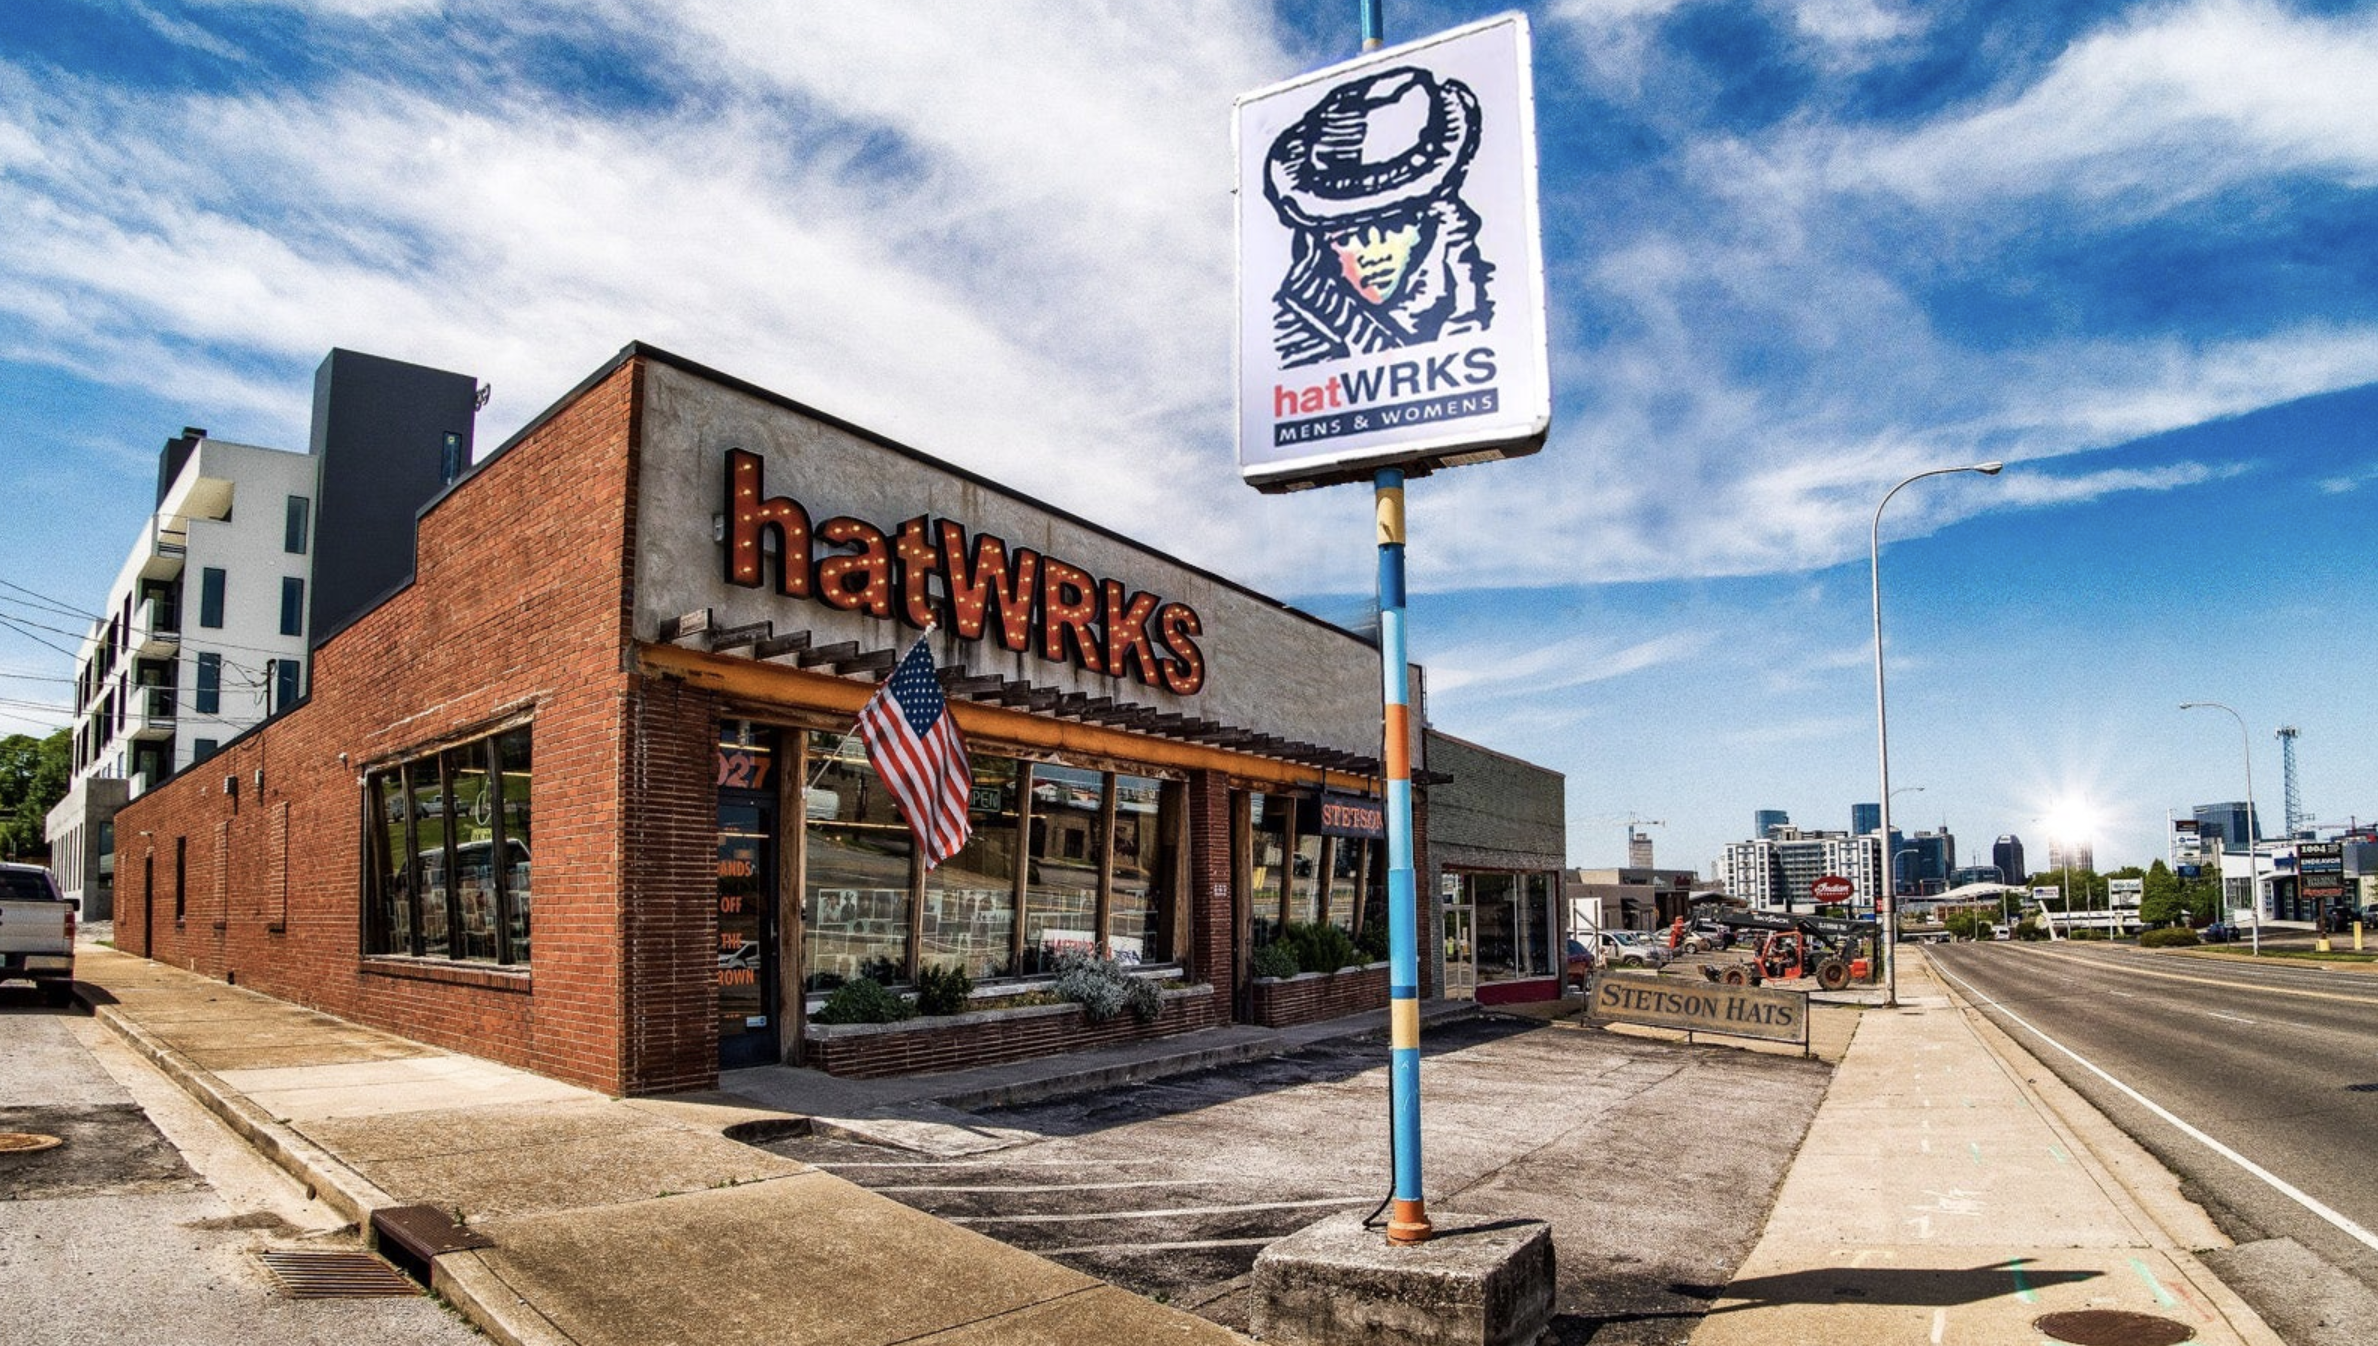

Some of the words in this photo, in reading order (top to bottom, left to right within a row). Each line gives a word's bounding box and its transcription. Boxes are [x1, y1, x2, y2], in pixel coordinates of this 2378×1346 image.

[1274, 347, 1497, 418] hatWRKS
[1279, 419, 1341, 442] MENS
[1353, 415, 1369, 430] &
[1381, 395, 1493, 425] WOMENS
[725, 448, 1204, 695] hatWRKS
[971, 790, 998, 808] PEN
[718, 860, 752, 877] ANDS
[721, 896, 743, 914] OFF
[721, 932, 743, 949] THE
[1601, 983, 1717, 1017] STETSON
[1726, 996, 1794, 1026] HATS
